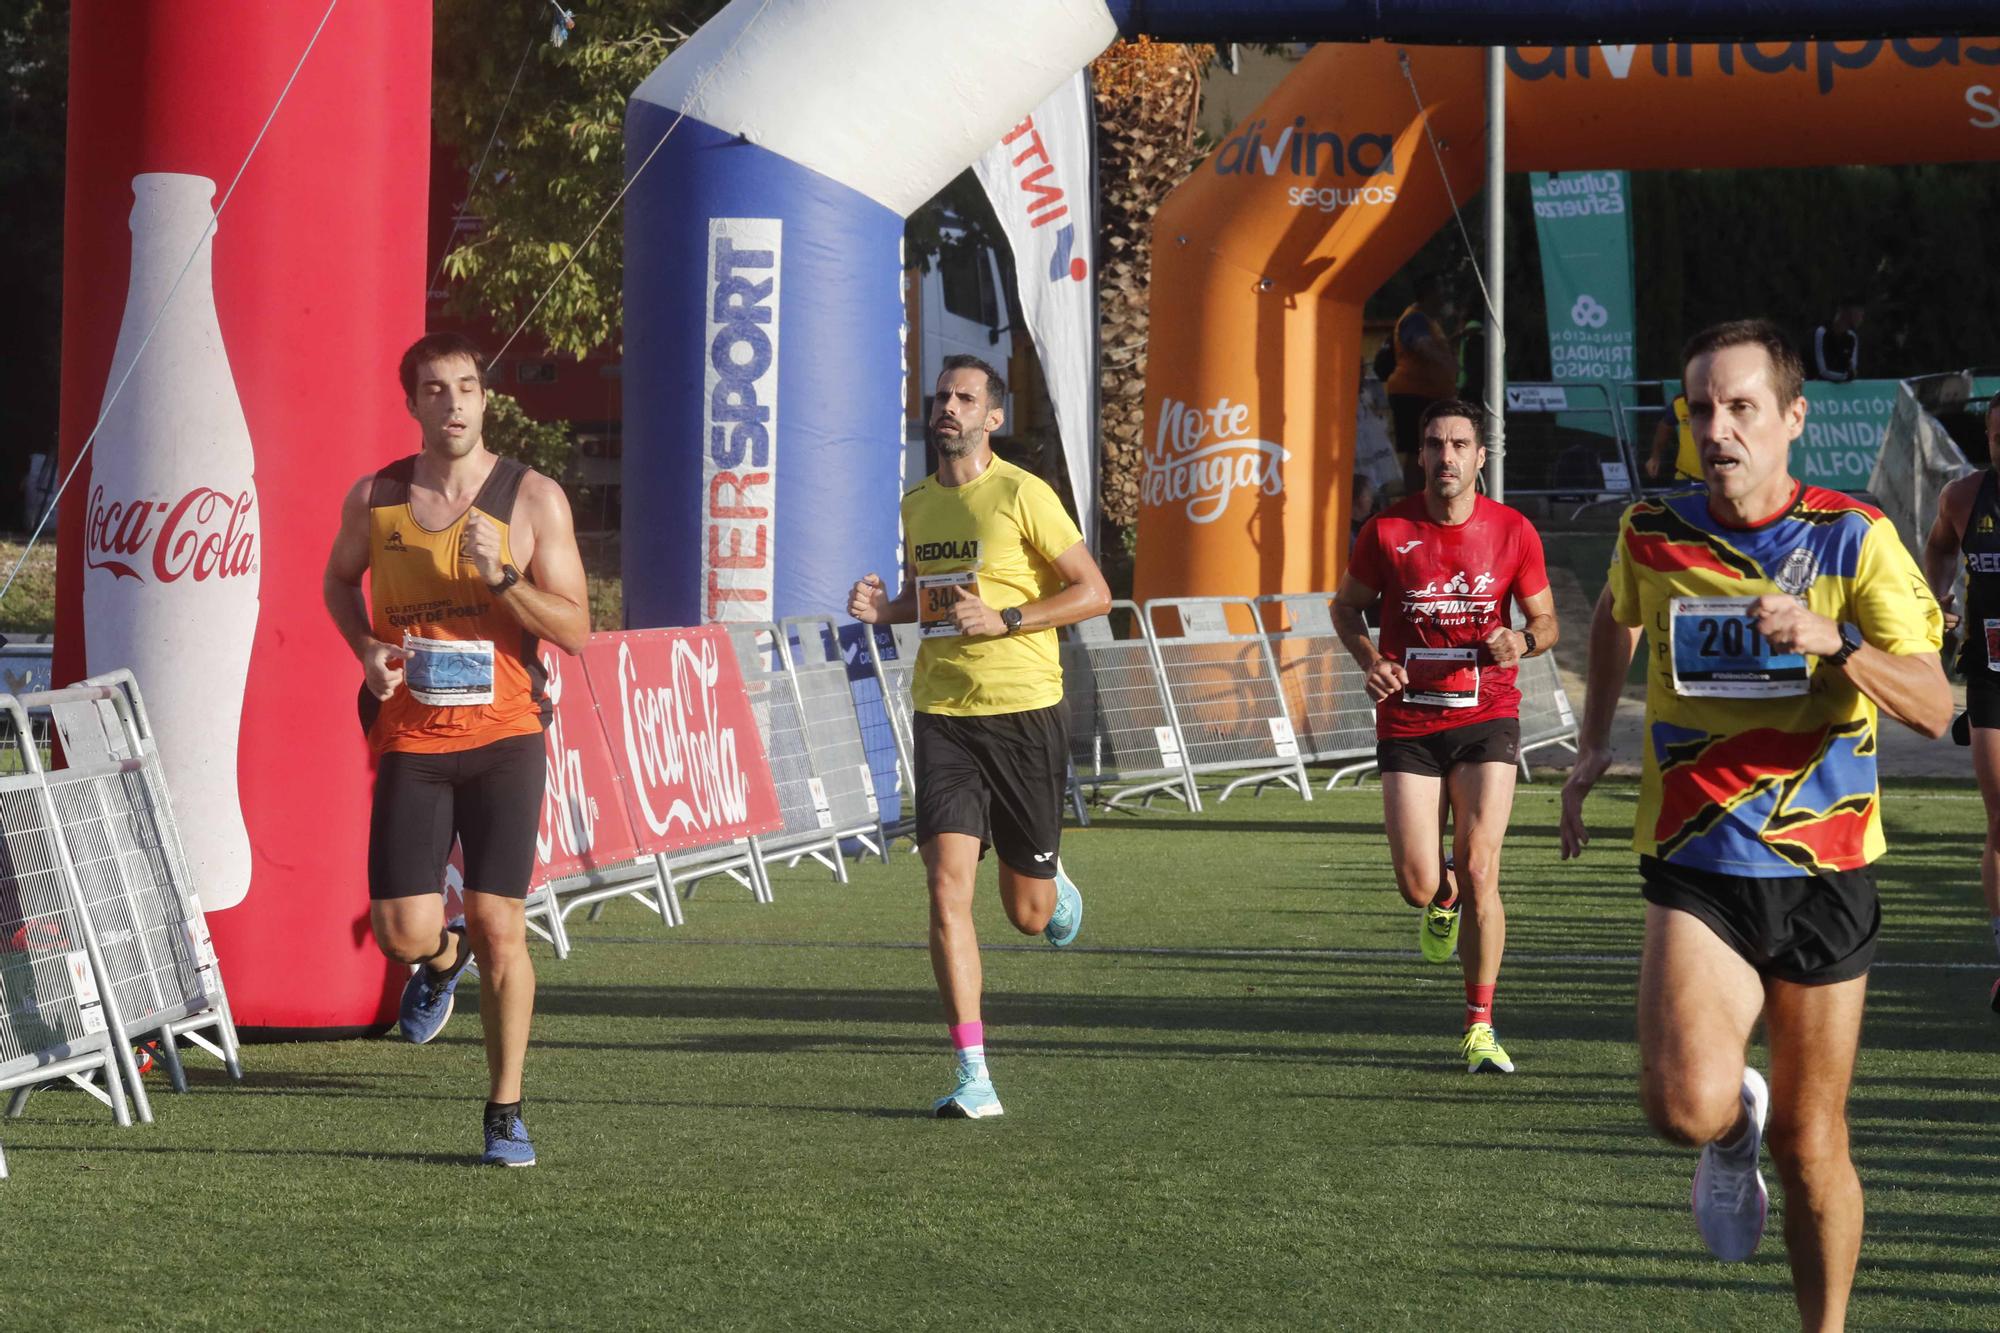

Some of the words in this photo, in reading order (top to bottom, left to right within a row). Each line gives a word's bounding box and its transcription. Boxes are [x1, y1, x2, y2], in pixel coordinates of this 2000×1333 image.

[1215, 115, 1395, 176] divina
[1288, 184, 1398, 212] seguros
[708, 236, 774, 640] TERSPORT
[1156, 398, 1210, 458] No
[1206, 398, 1250, 438] te
[1799, 421, 1887, 448] TRINIDA
[1141, 440, 1291, 524] detengas
[1804, 451, 1877, 477] ALFON
[86, 485, 255, 584] Coca-Cola
[427, 609, 443, 622] DE
[1699, 617, 1780, 657] 201
